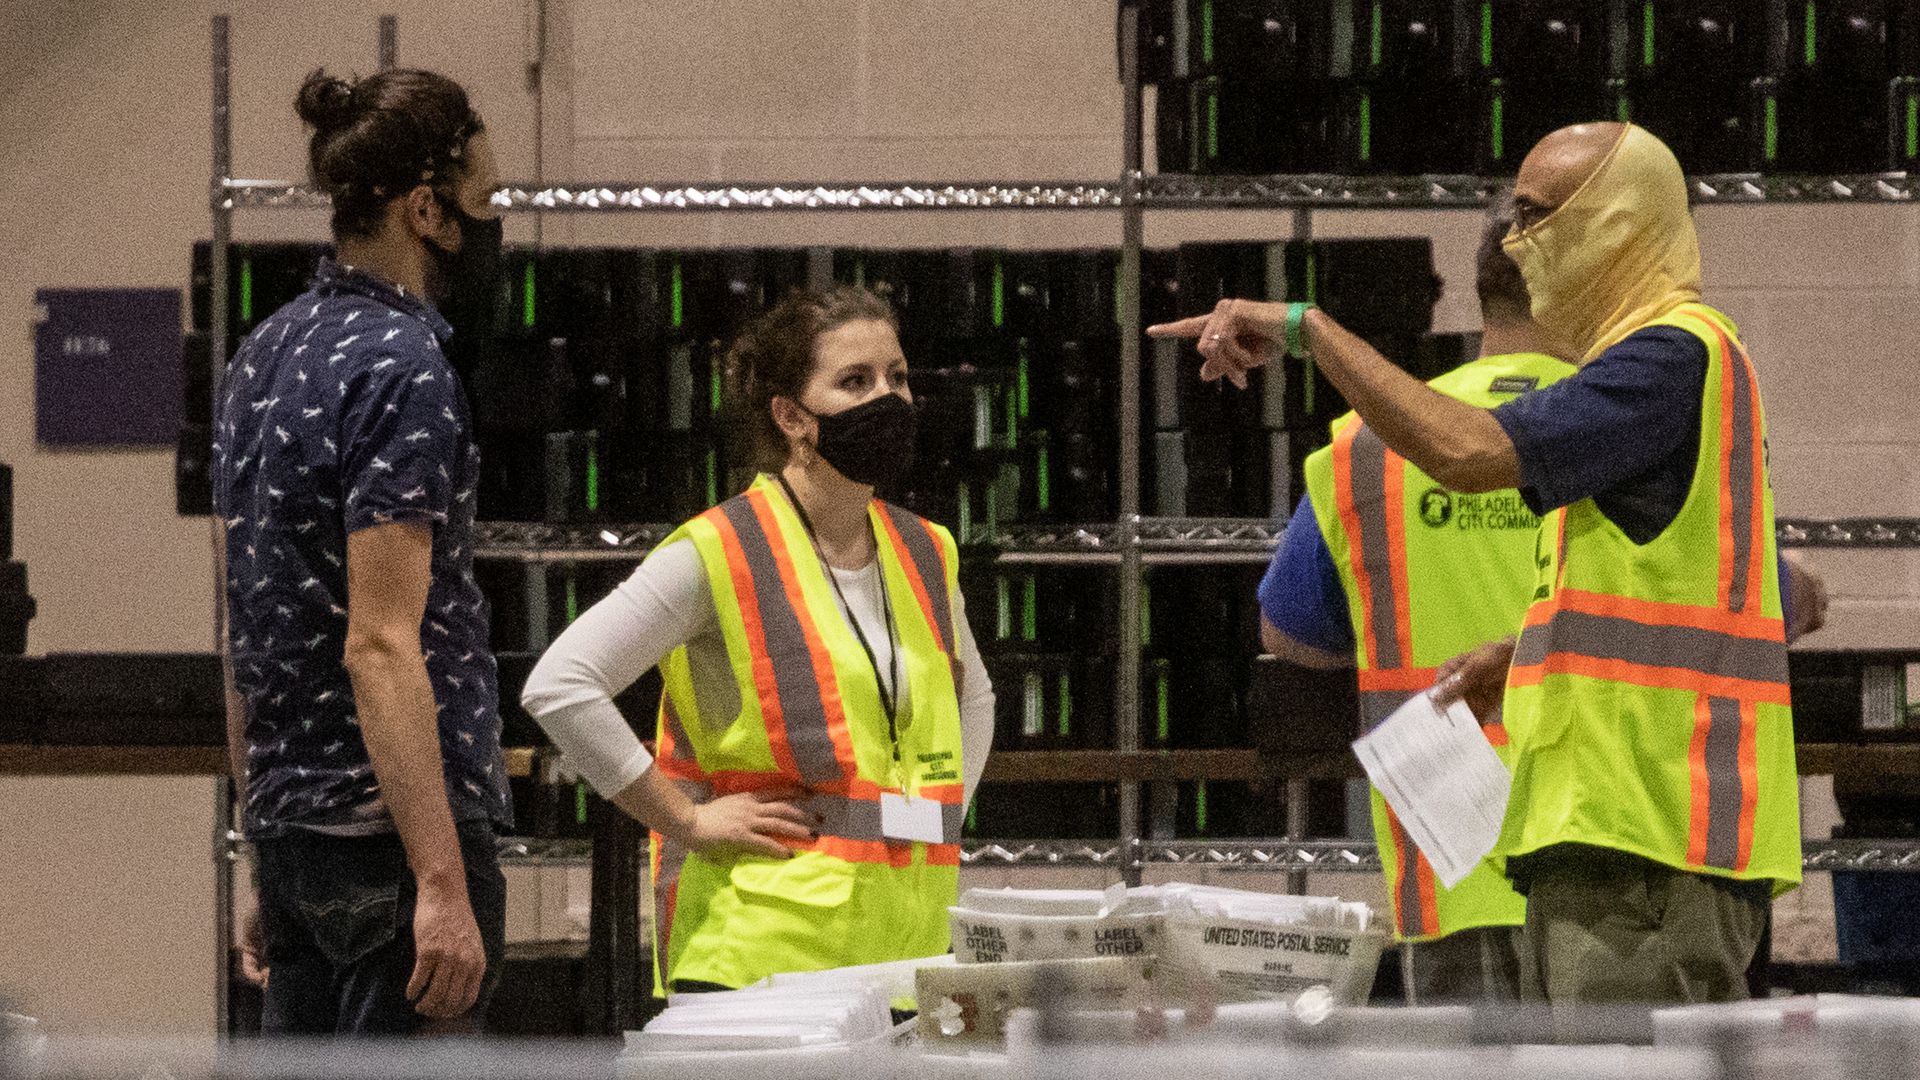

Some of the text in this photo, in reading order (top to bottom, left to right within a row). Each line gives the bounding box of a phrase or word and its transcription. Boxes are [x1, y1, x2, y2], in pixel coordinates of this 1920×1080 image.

[1458, 513, 1482, 530] CITY
[965, 923, 1002, 938] LABEL
[1095, 928, 1141, 941] LABEL
[966, 936, 1007, 952] OTHER
[1095, 940, 1143, 955] OTHER
[1204, 926, 1351, 956] UNITED STATES POSTAL SERVICE
[975, 950, 1002, 962] END
